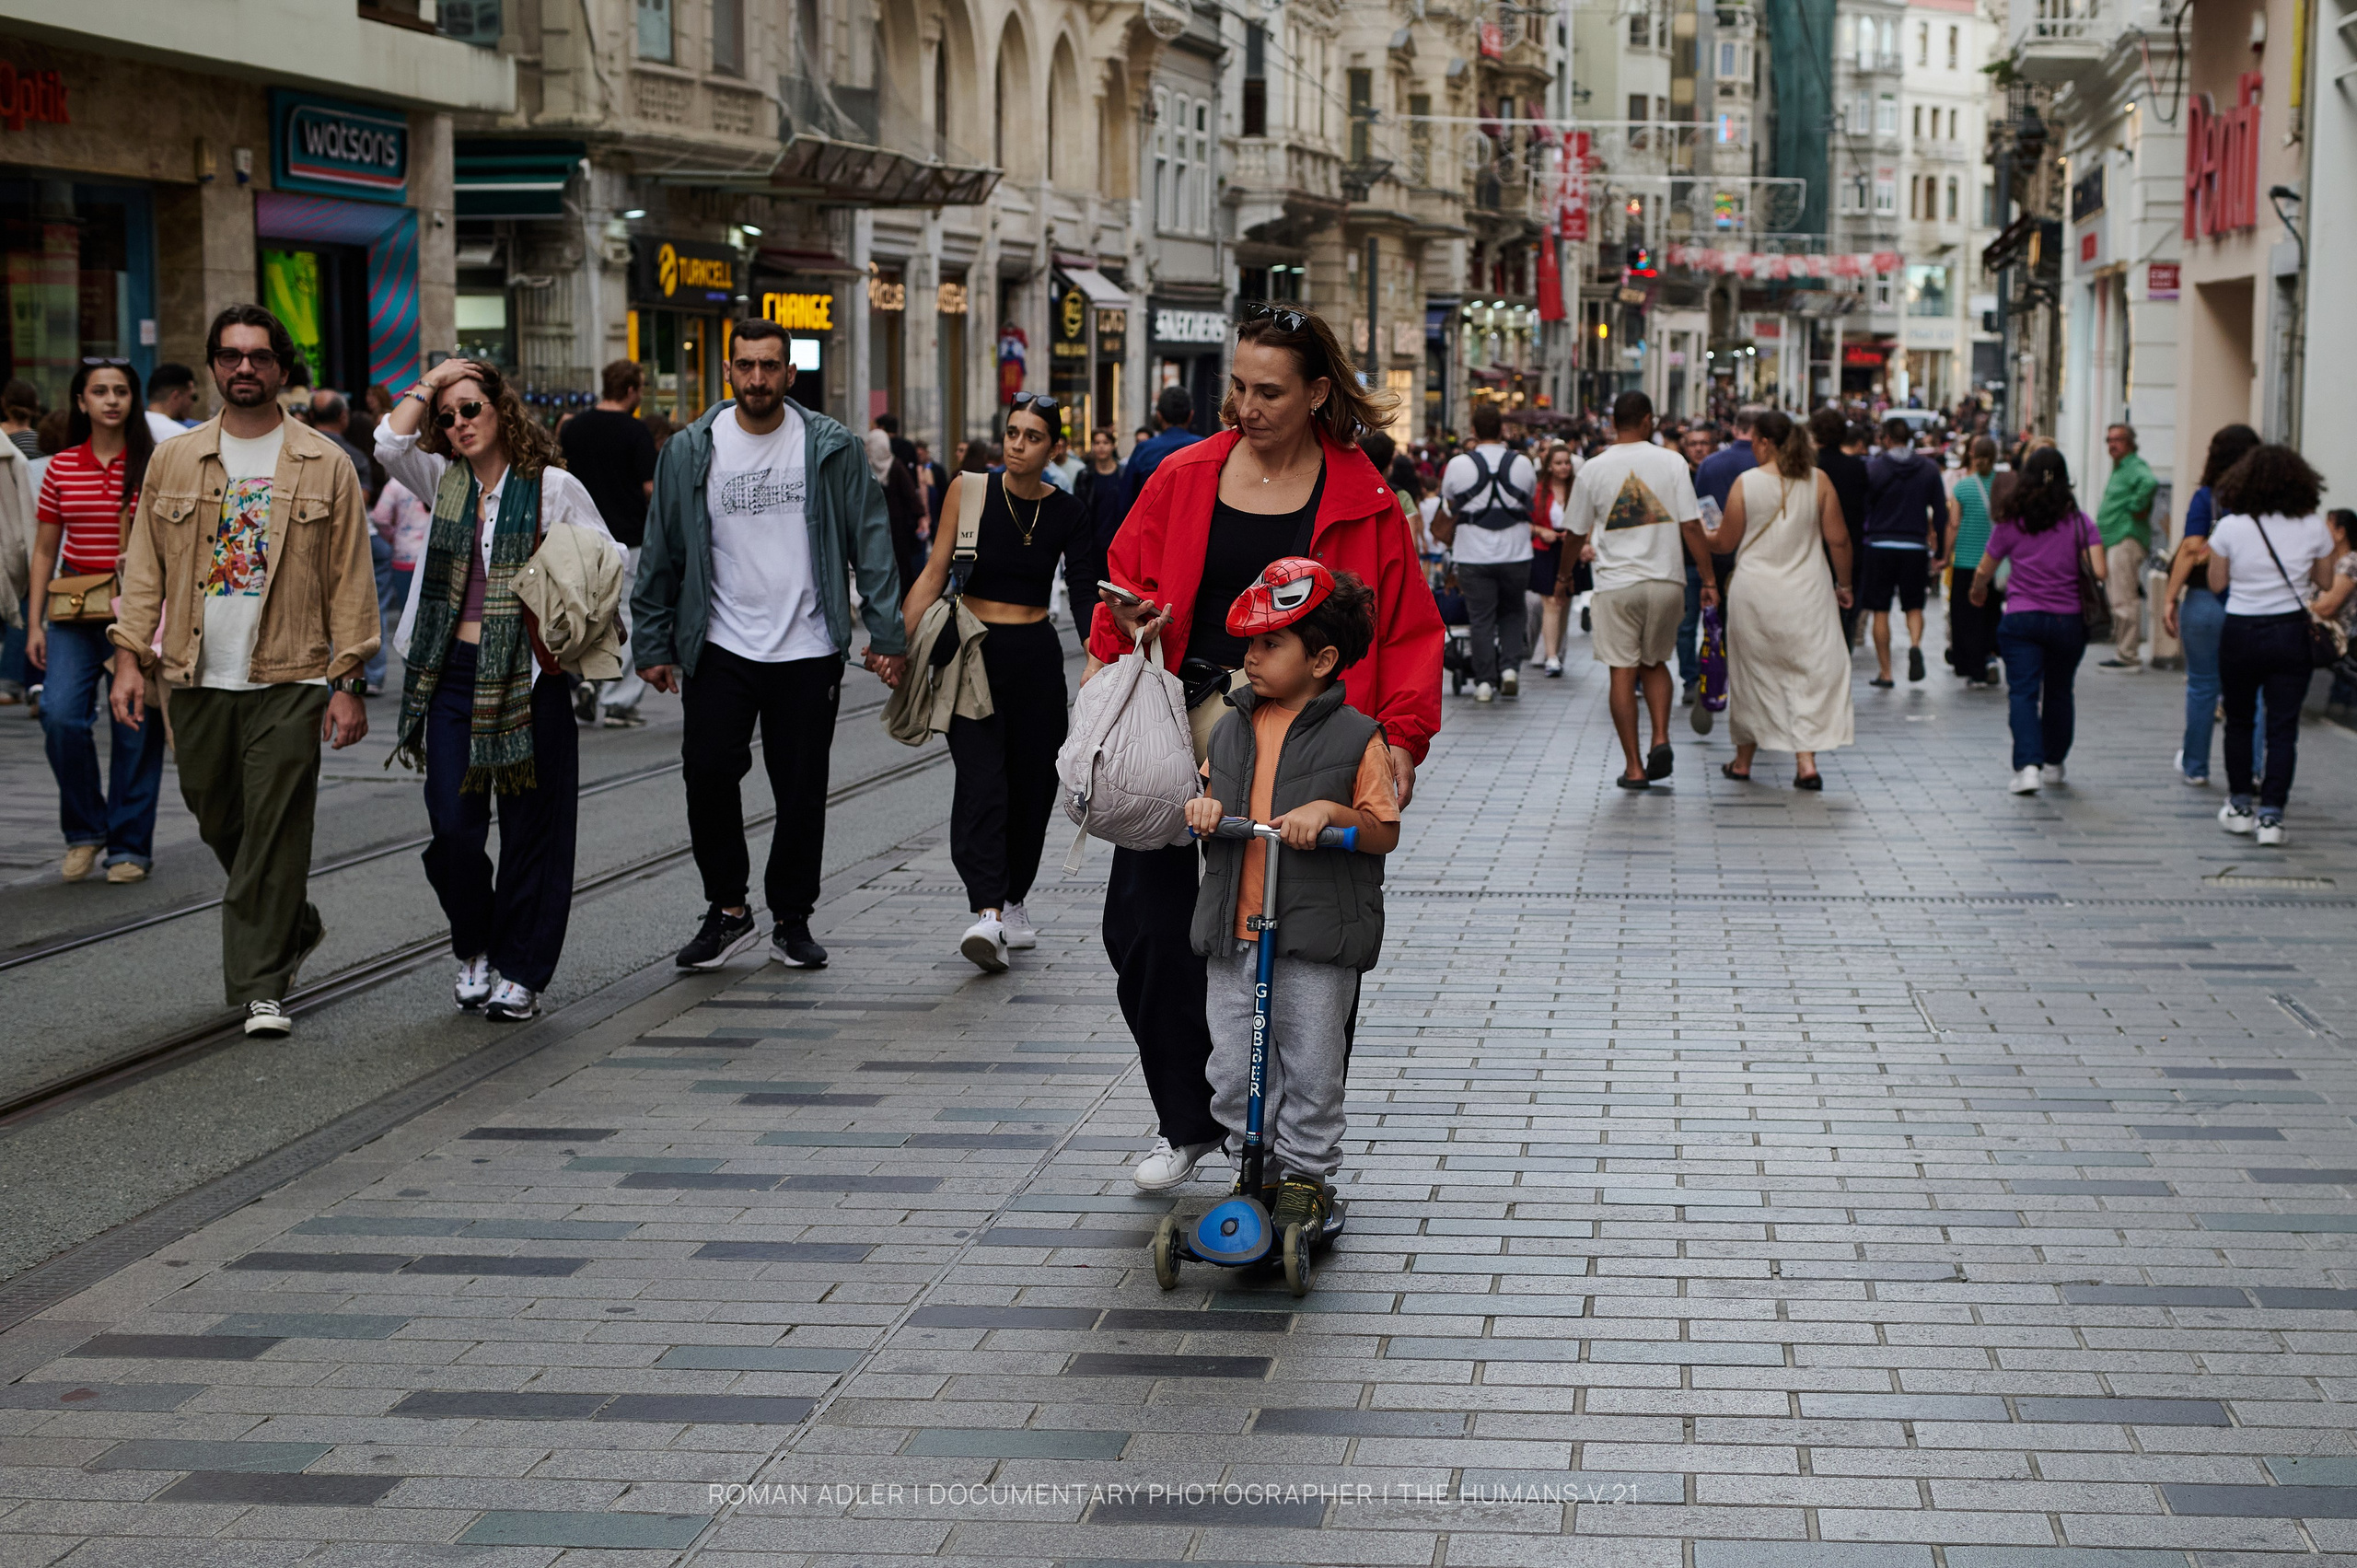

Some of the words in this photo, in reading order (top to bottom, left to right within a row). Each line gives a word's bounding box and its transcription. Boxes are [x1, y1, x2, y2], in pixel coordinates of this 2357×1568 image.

[0, 60, 71, 131] Optik
[303, 119, 398, 168] watsons
[762, 292, 834, 331] CHANGE
[960, 530, 975, 539] MT
